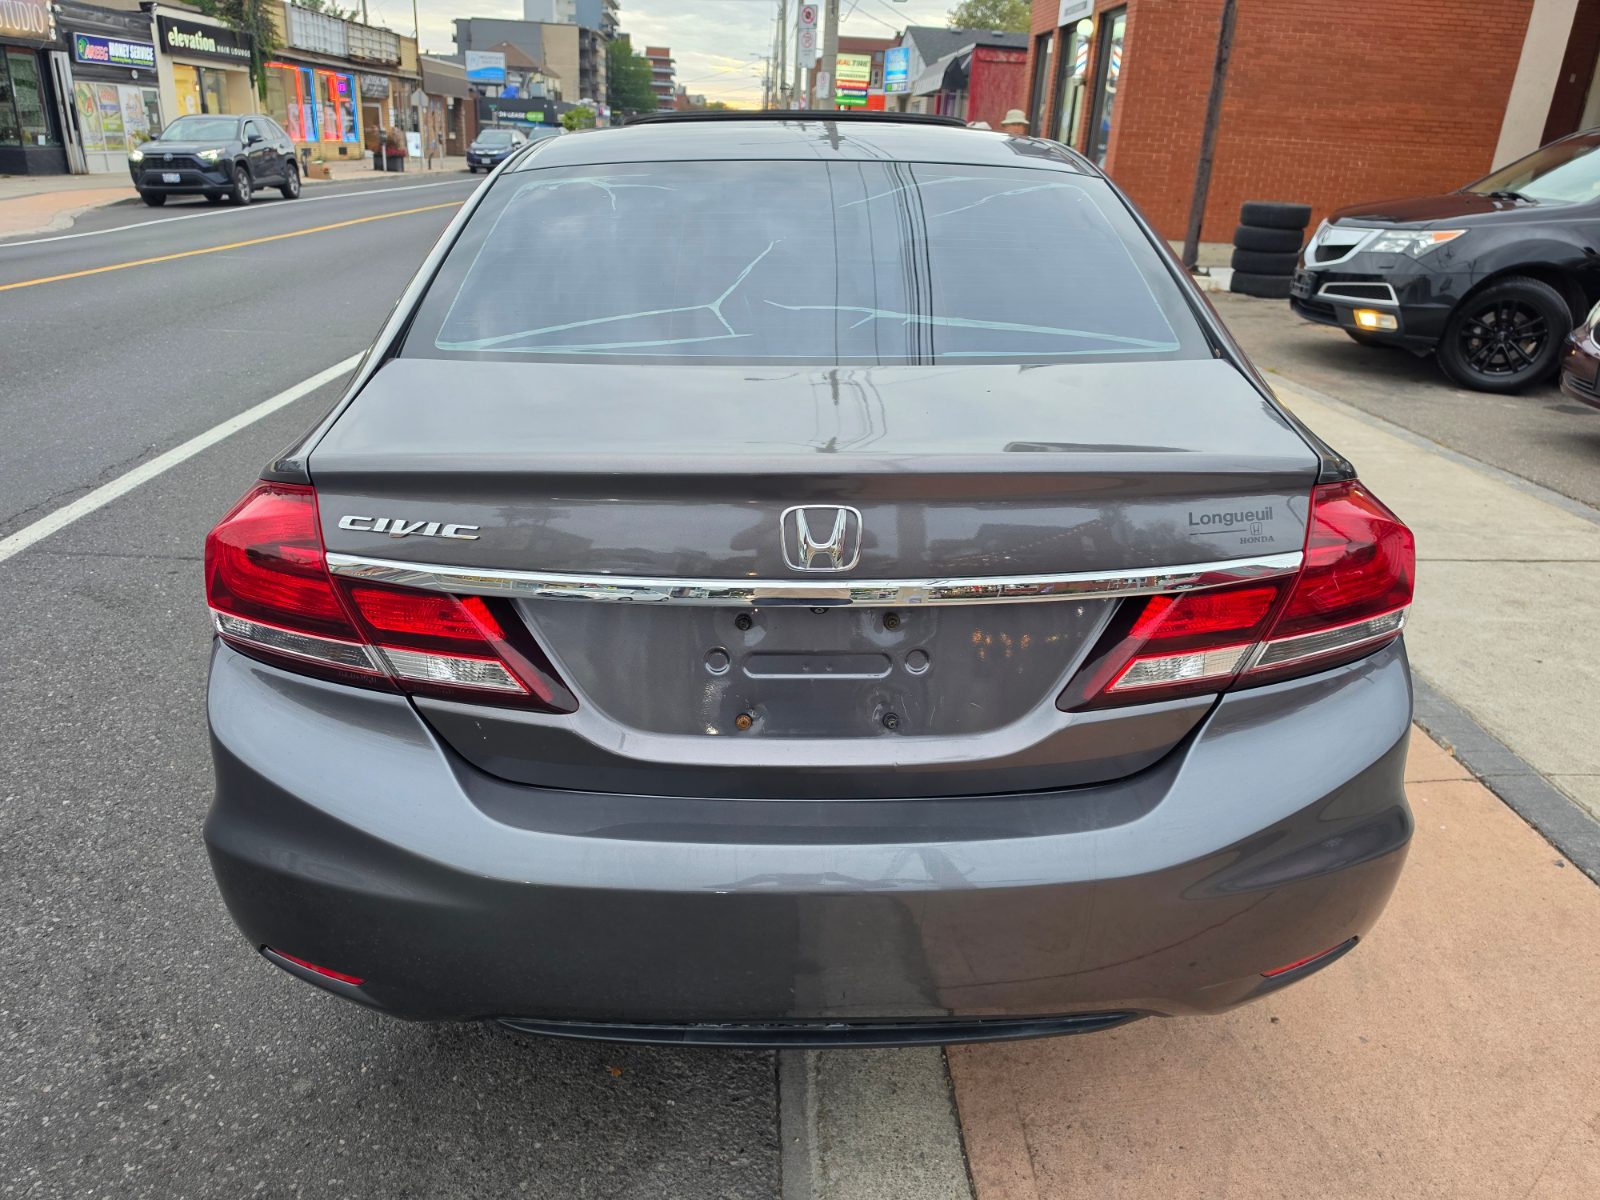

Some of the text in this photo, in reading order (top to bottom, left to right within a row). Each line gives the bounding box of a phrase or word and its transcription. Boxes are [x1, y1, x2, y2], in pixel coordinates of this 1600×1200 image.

[0, 0, 44, 33] TUDIO
[167, 26, 216, 52] elevation
[108, 42, 129, 57] MONEY
[129, 44, 154, 61] SERVICE
[1188, 506, 1274, 526] Longueuil
[338, 515, 480, 540] CIVIC
[1239, 535, 1275, 545] HONDA
